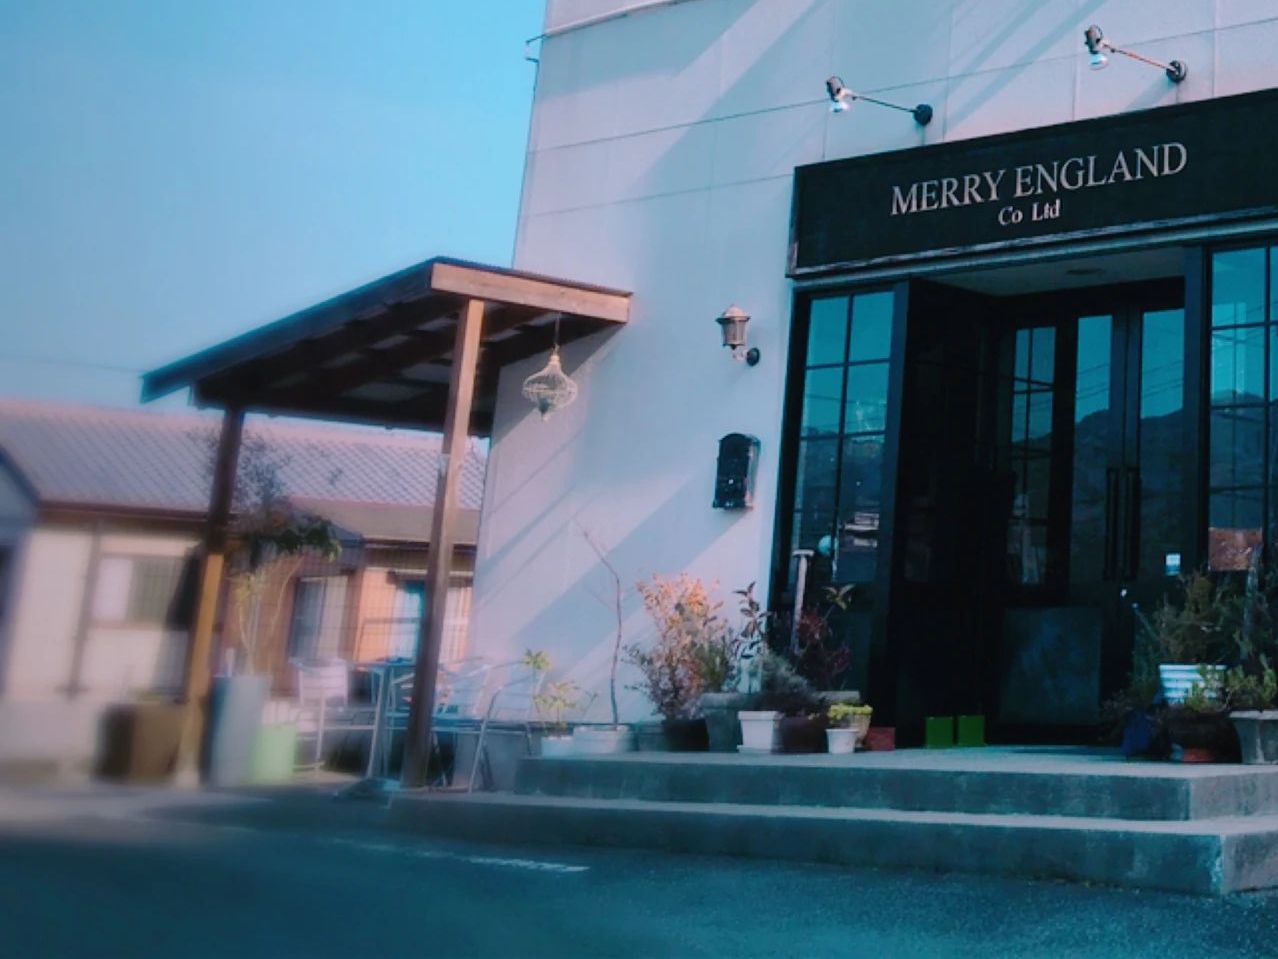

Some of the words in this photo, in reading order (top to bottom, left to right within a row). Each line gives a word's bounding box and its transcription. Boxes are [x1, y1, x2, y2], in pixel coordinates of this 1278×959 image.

[890, 169, 1006, 217] MERRY
[1014, 142, 1188, 196] ENGLAND
[997, 205, 1024, 226] Co
[1031, 199, 1061, 222] Ltd
